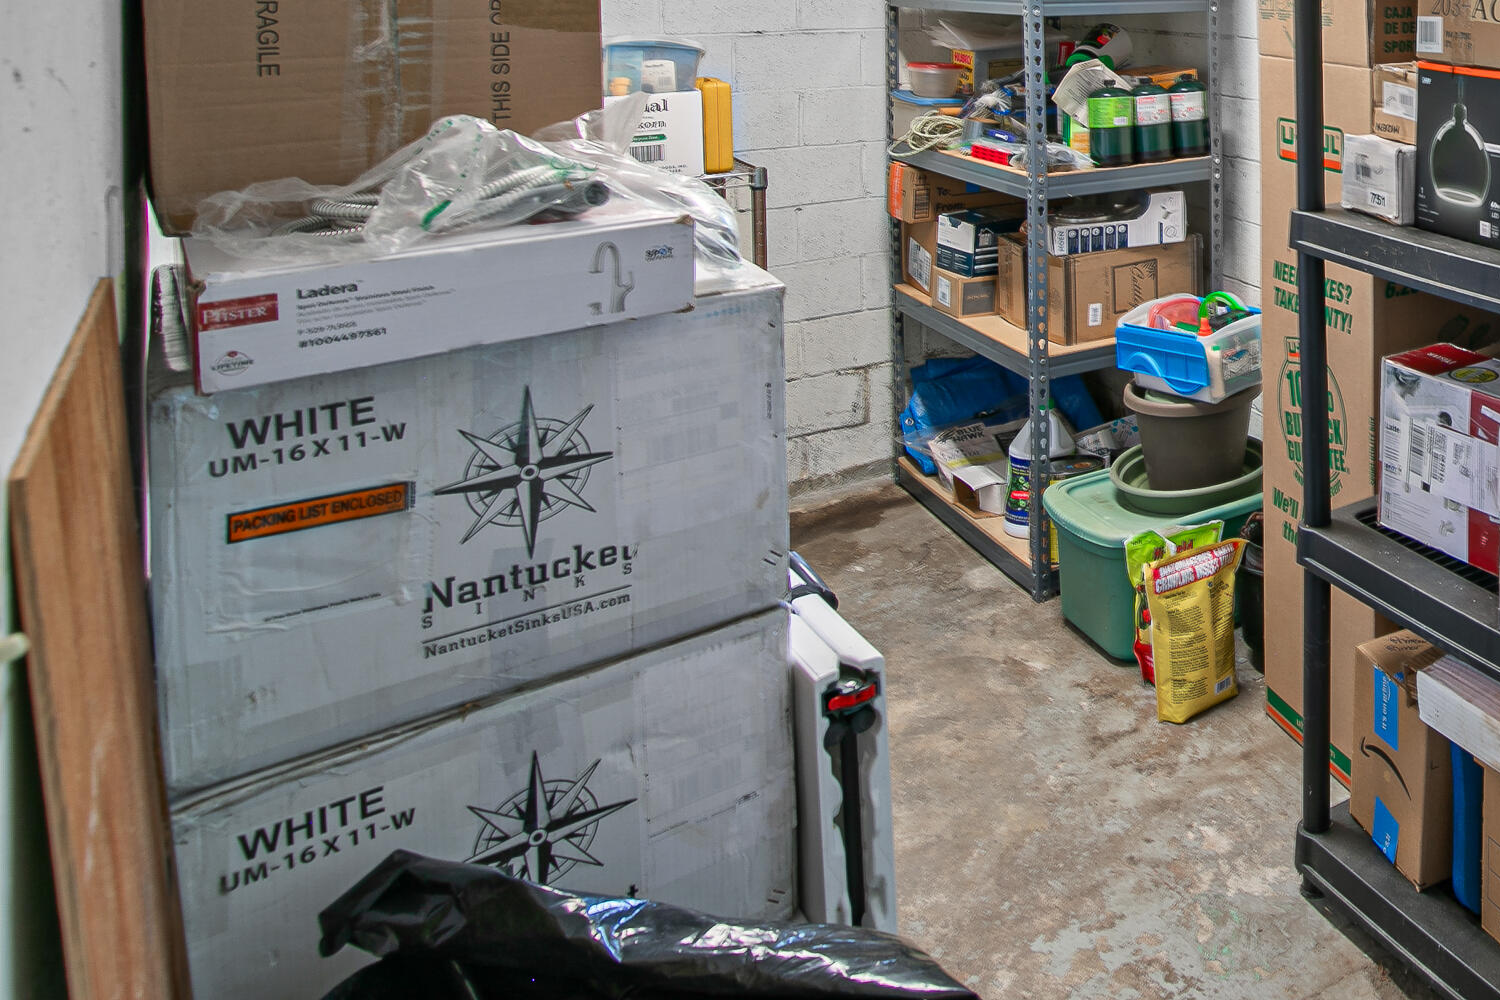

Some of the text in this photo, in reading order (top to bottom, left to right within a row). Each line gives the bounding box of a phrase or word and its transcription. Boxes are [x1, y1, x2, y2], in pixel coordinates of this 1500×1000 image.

[1384, 7, 1412, 19] CAJA
[1384, 23, 1398, 34] DE
[490, 31, 511, 79] SIDE
[492, 82, 511, 123] THIS
[1273, 260, 1298, 287] NEE
[297, 283, 358, 299] Ladera
[226, 396, 376, 449] WHITE
[957, 425, 984, 437] BLUE
[1385, 424, 1400, 433] Lade
[950, 431, 985, 443] HAWK
[233, 489, 403, 533] PACKING LIST ENCLOSED
[1273, 487, 1298, 520] We'll
[425, 593, 631, 660] NantucketSinksUSA.com
[1381, 676, 1389, 702] prime
[237, 786, 385, 860] WHITE
